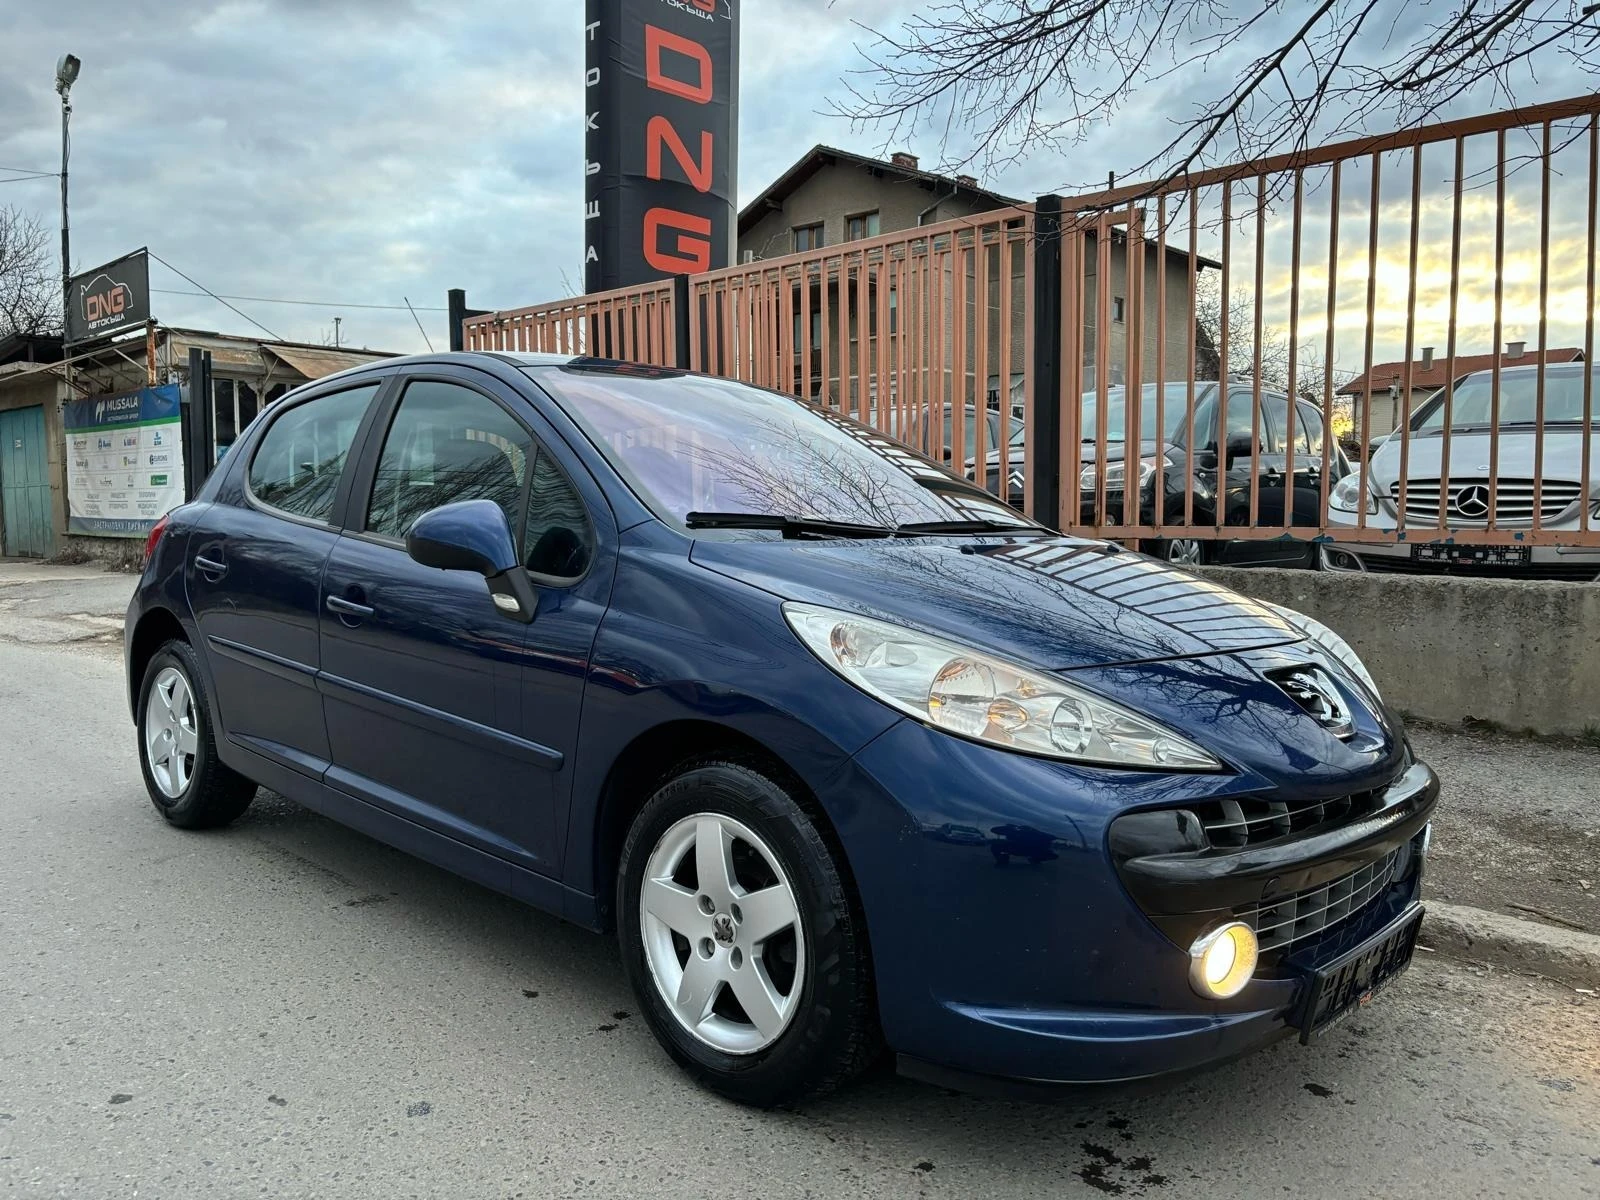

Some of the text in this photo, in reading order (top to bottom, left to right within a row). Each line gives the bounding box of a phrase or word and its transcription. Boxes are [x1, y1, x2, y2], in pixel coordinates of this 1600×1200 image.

[643, 23, 713, 275] DNG
[86, 286, 125, 321] DNG
[88, 313, 125, 330] АВТОКЪША
[106, 396, 138, 412] MUSSALA
